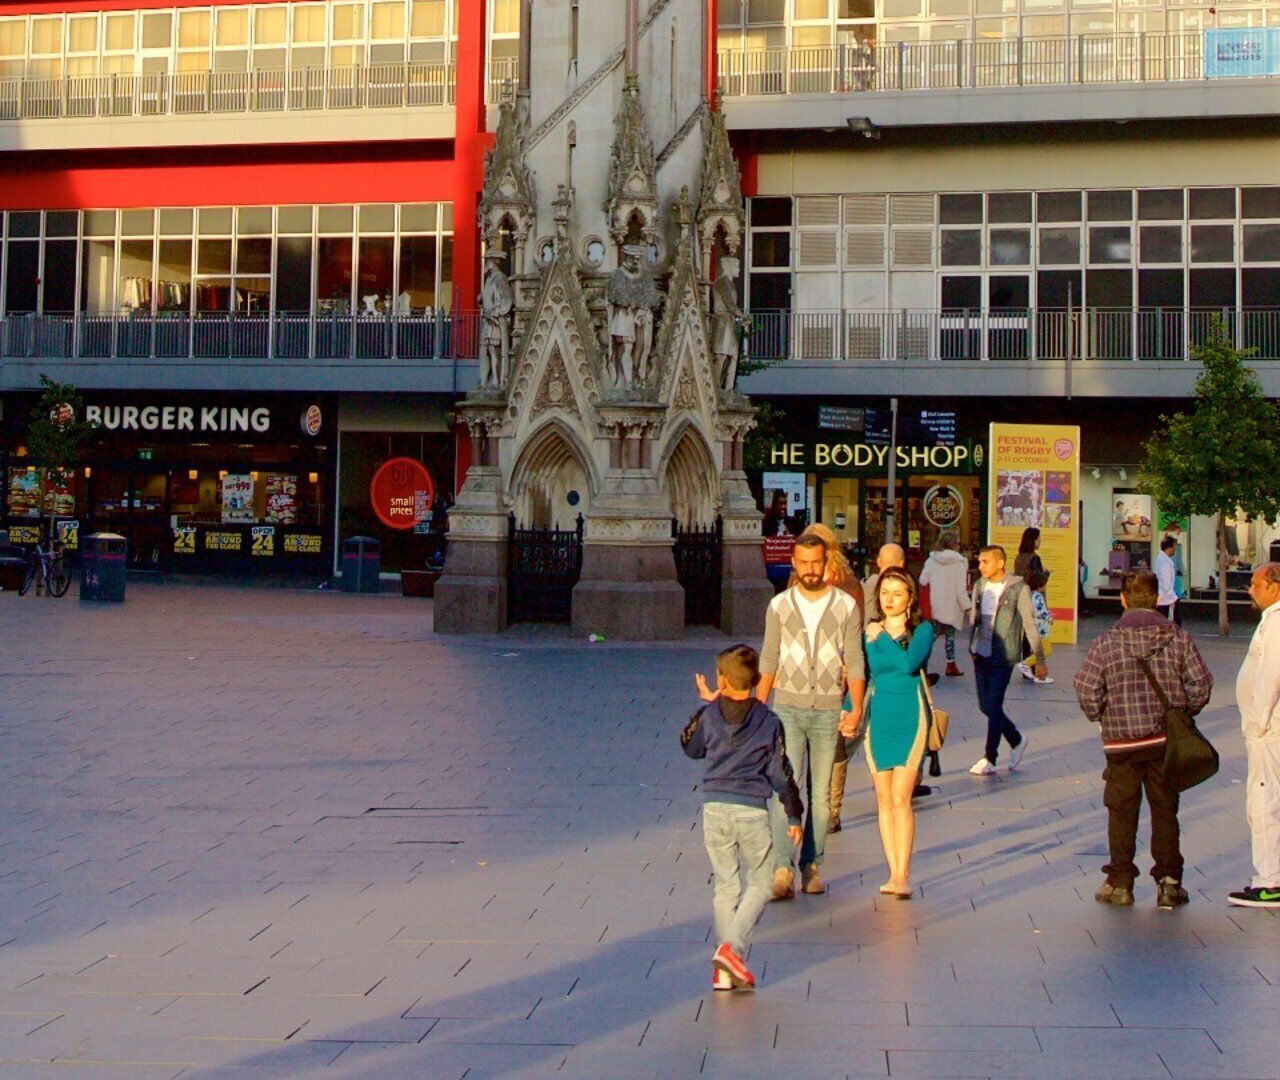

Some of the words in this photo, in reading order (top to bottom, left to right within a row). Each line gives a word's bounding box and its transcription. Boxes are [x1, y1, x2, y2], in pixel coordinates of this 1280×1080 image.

[86, 405, 194, 431] BURGER
[200, 407, 270, 431] KING
[997, 435, 1049, 446] FESTIVAL
[771, 443, 805, 465] HE
[815, 443, 888, 466] BODY
[896, 444, 969, 468] SHOP
[998, 446, 1012, 455] OF
[1014, 446, 1053, 456] RUGBY
[1013, 456, 1050, 465] OCTOBER
[391, 496, 414, 507] small
[390, 507, 414, 517] prices
[252, 526, 274, 535] OPEN
[174, 532, 196, 548] 24
[251, 535, 275, 551] 24
